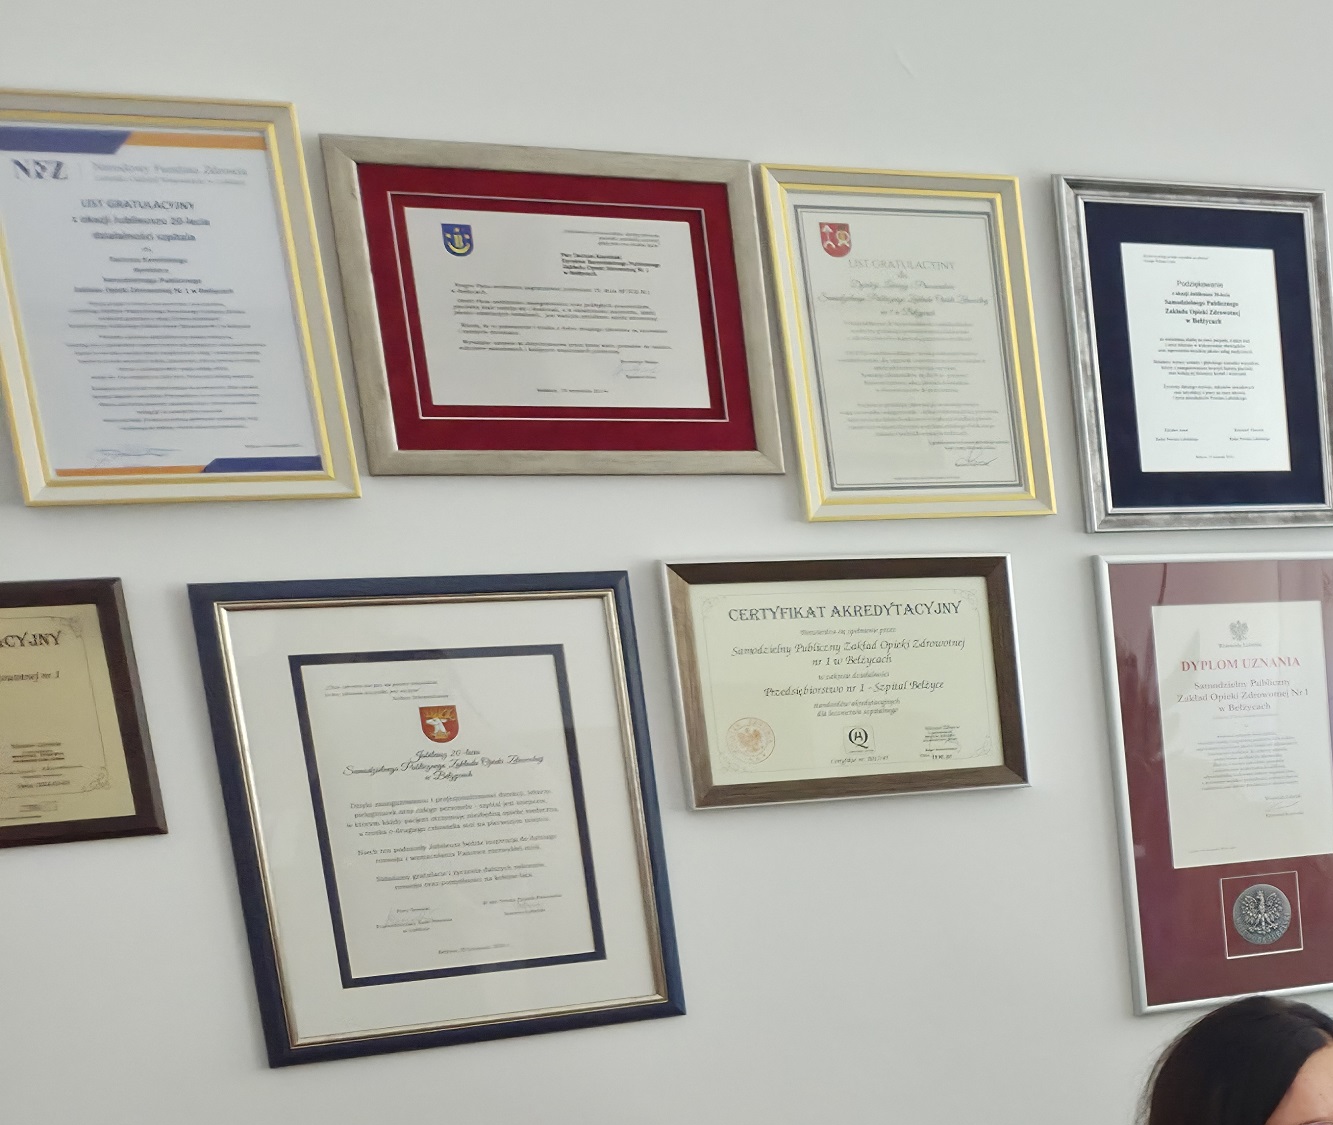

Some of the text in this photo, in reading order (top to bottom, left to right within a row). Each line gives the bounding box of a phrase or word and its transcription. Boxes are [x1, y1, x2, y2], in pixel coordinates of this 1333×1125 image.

[728, 600, 962, 621] CERTYFIKAT AKREDYTACYJNY
[731, 638, 965, 657] Samodzielny Publiczny Zakład Opieki Zdrowotnej
[1181, 656, 1301, 672] DYPLOM UZNANIA
[763, 685, 844, 697] Przedsiębiorstwo
[873, 681, 907, 695] Szpital
[1194, 678, 1290, 690] Samodzielny Publiczny
[1177, 694, 1208, 703] Zakład
[1210, 692, 1239, 702] Opieki
[1241, 690, 1289, 700] Zdrowotnej
